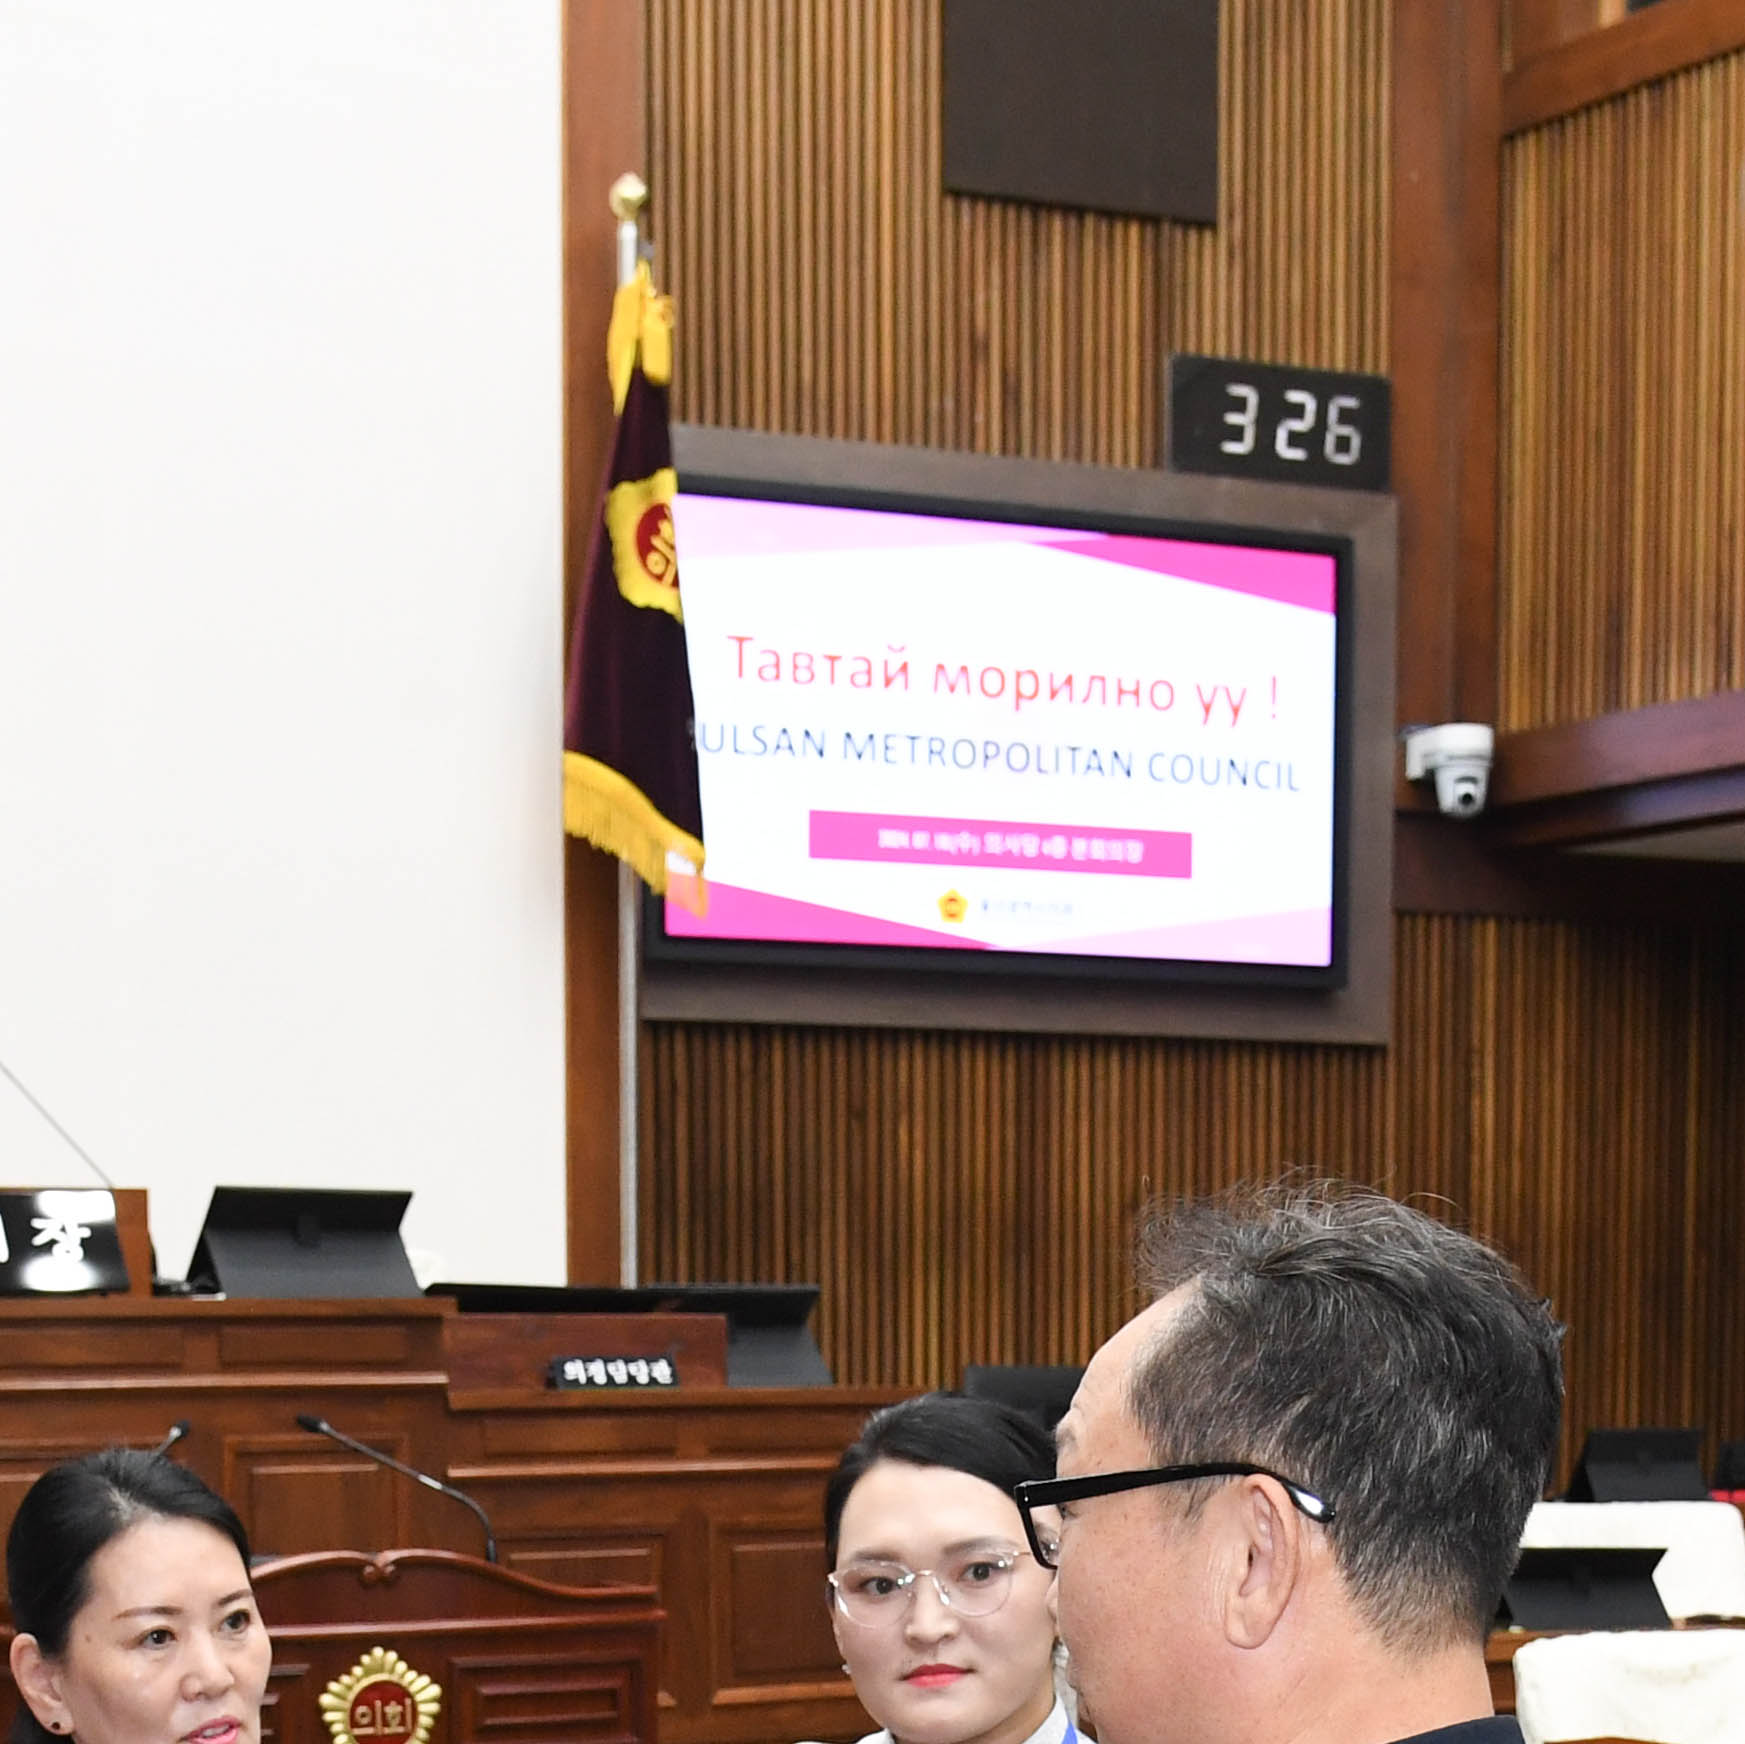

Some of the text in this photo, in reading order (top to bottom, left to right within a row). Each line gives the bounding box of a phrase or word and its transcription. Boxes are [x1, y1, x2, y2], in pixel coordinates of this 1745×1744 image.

[726, 635, 910, 692] Тавтай
[933, 662, 1175, 712] морилно
[1195, 683, 1248, 728] уу
[700, 723, 1301, 791] ULSAN METROPOLITAN COUNCIL
[351, 1696, 413, 1736] 의회
